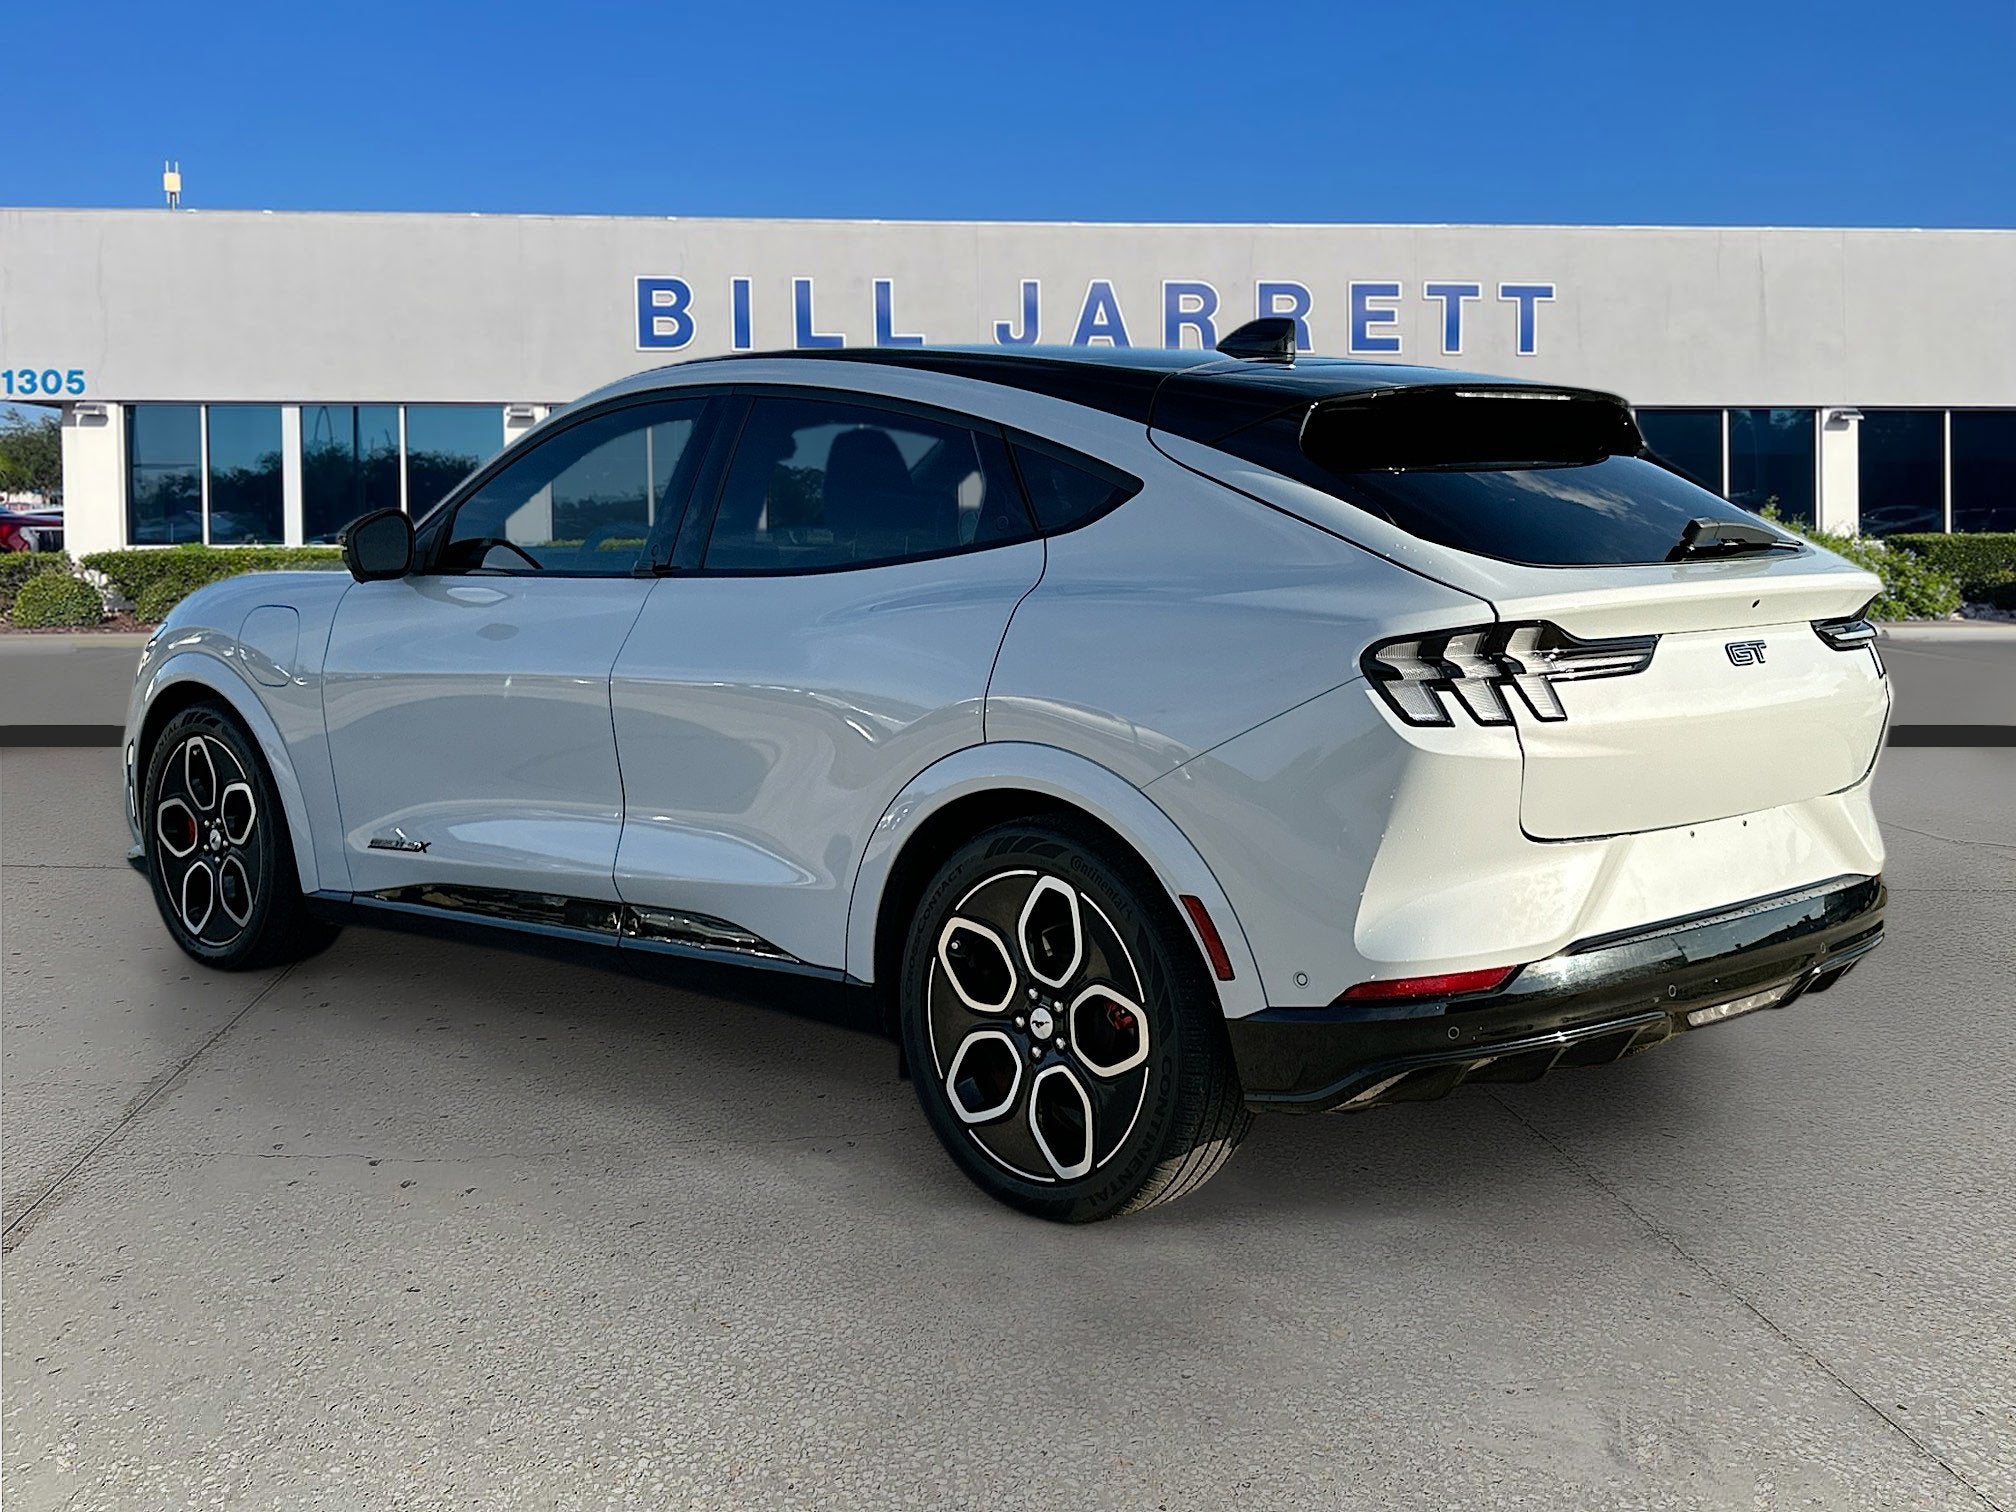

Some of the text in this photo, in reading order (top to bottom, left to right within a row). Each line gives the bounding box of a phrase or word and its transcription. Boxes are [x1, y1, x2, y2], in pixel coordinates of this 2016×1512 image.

[634, 276, 1557, 356] BILL JARRETT
[1, 368, 86, 395] 1305
[1724, 639, 1767, 667] GT
